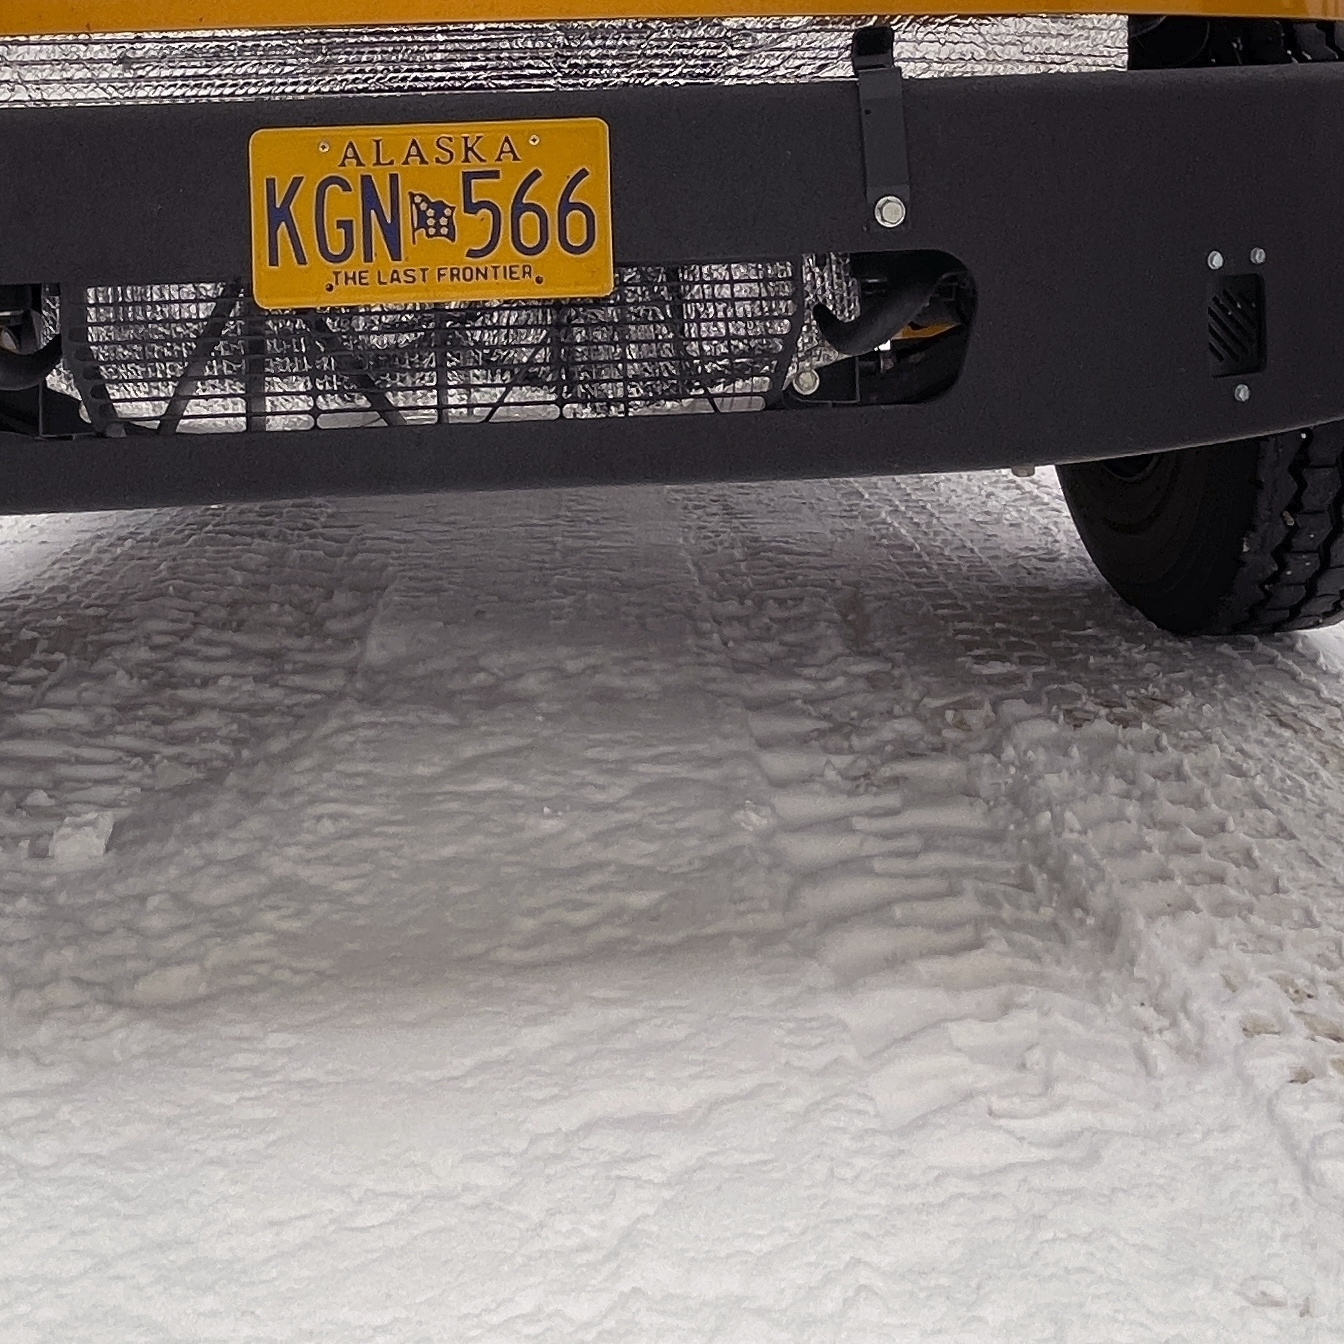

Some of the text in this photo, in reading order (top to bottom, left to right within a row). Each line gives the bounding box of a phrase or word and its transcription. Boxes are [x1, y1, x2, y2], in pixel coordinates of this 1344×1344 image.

[338, 134, 522, 168] ALASKA
[264, 167, 598, 268] KGN 566
[332, 264, 533, 287] THE LAST FRONTIER
